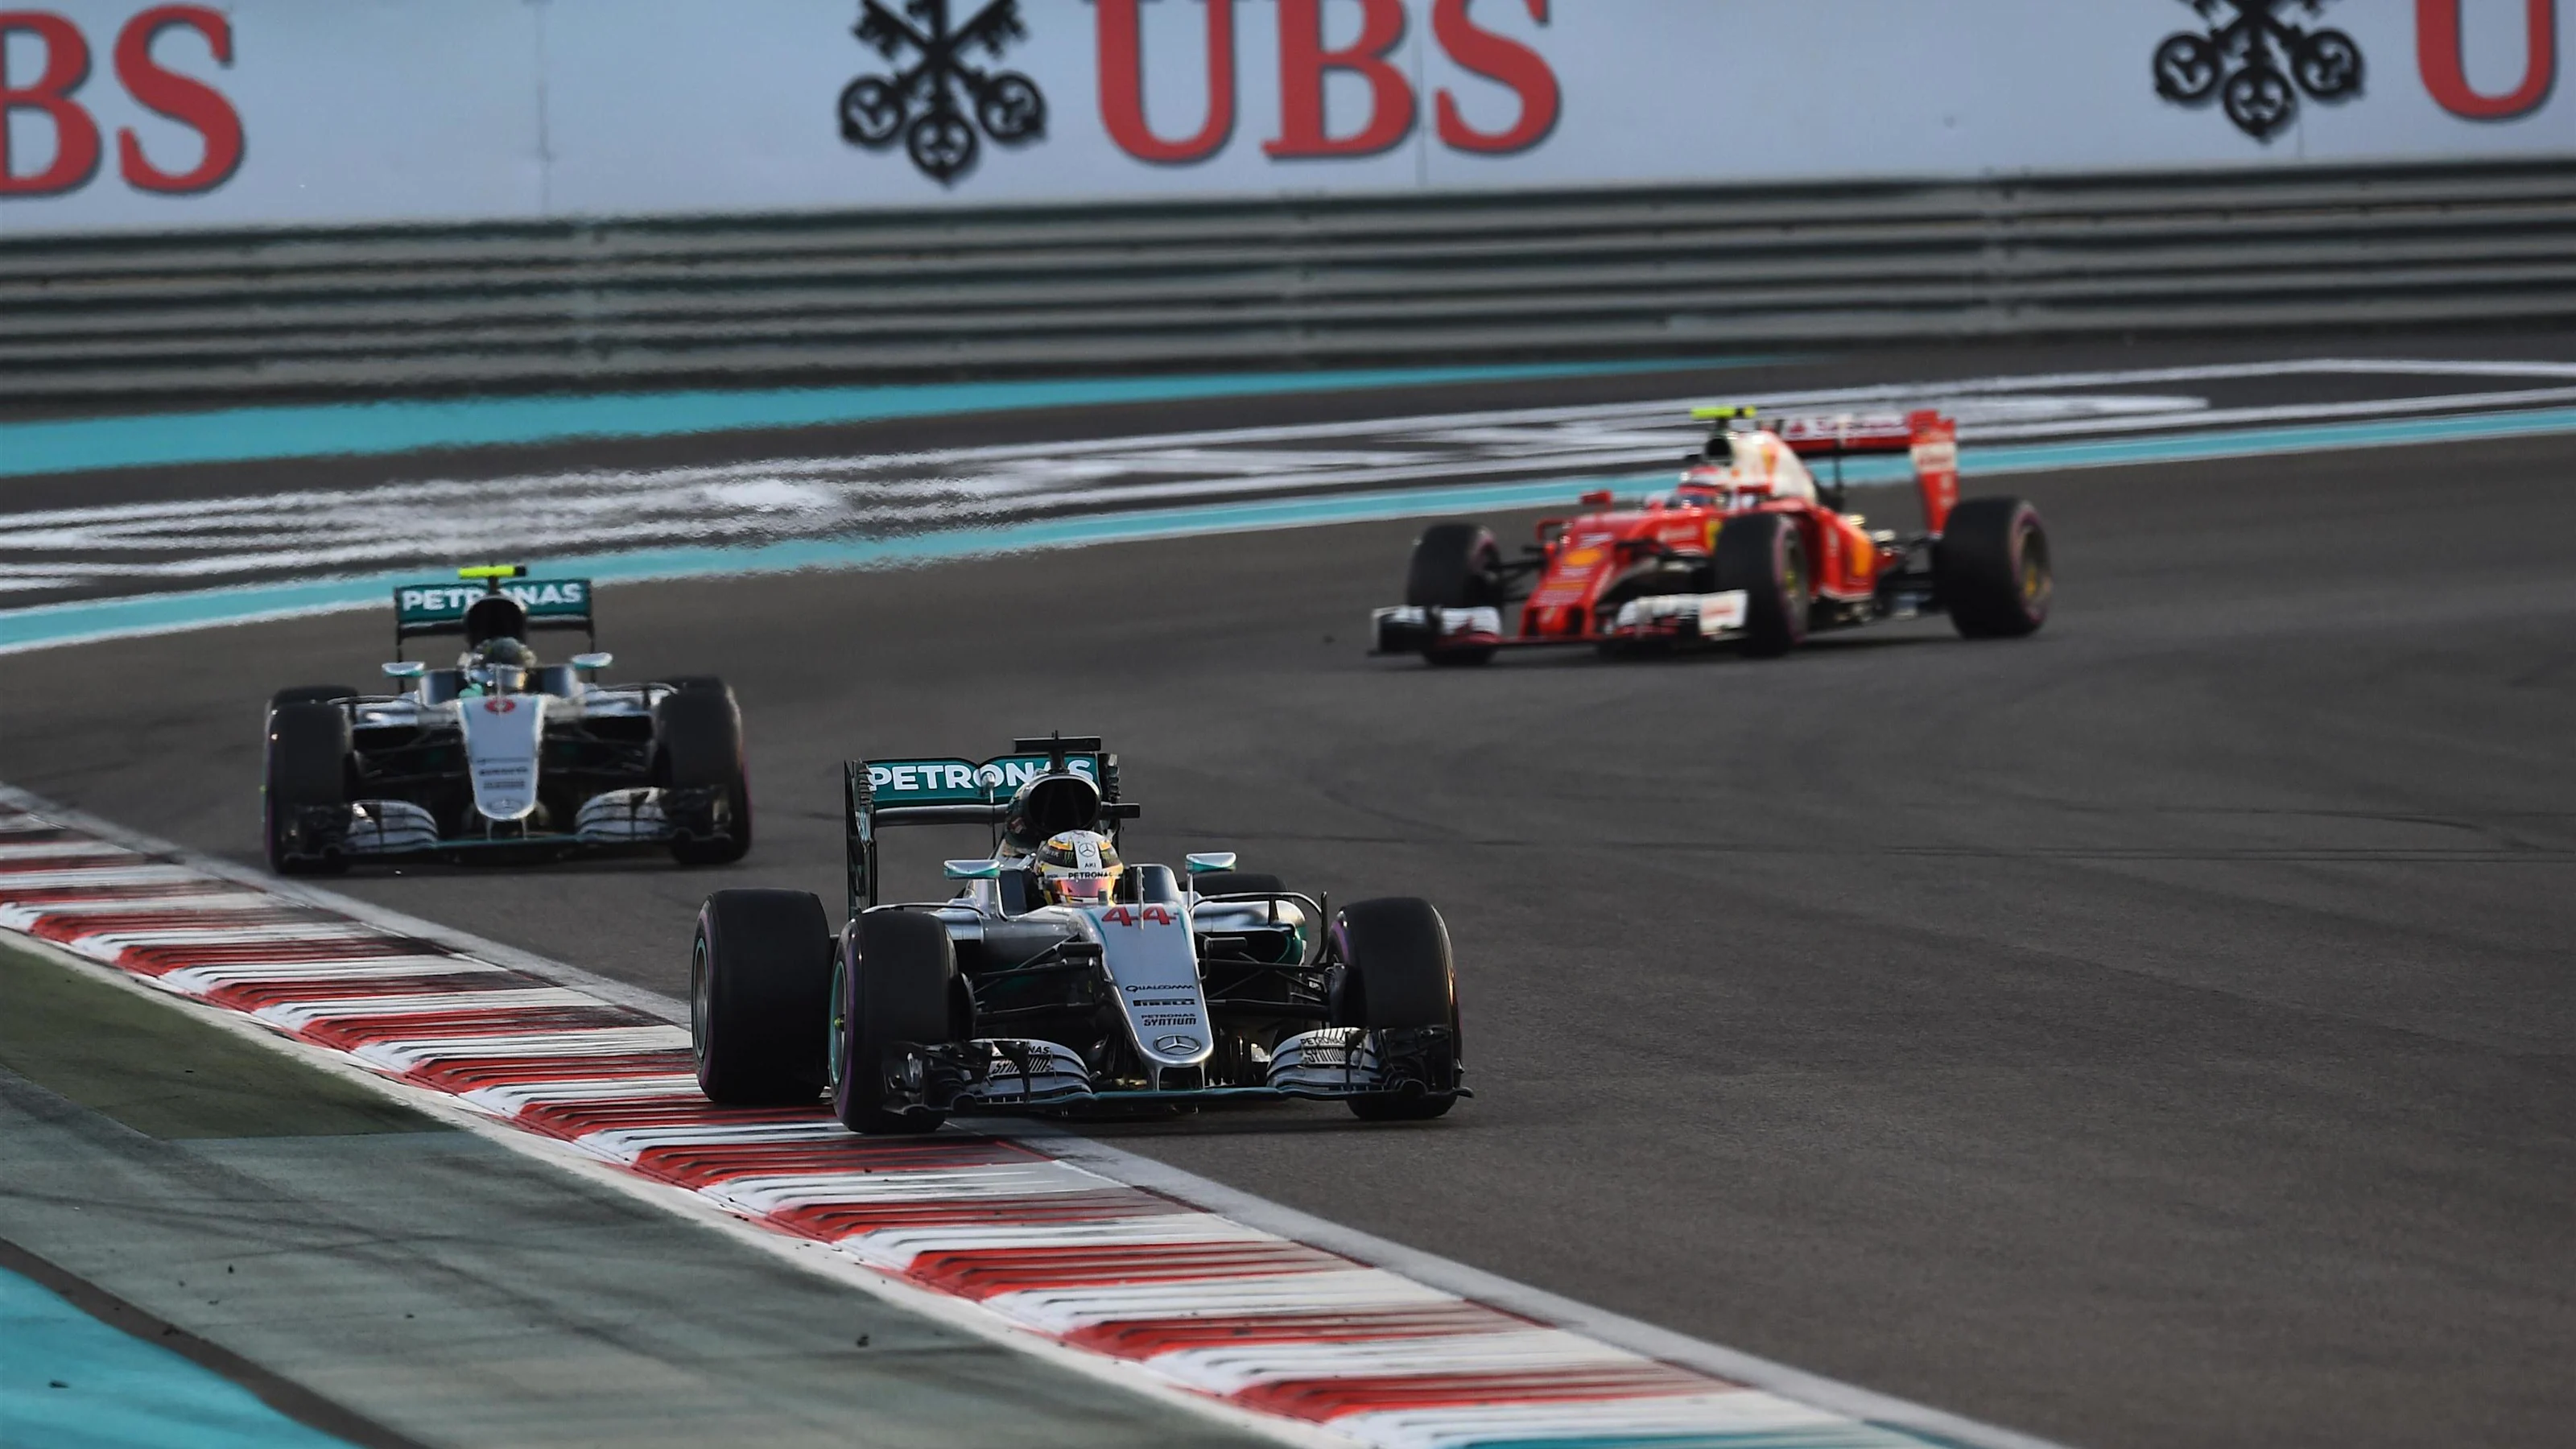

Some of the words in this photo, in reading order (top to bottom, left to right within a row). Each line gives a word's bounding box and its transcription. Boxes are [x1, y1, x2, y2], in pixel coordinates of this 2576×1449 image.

[2417, 0, 2556, 122] U
[1093, 0, 1561, 165] UBS
[402, 583, 581, 611] PETRNAS
[869, 759, 1094, 791] PETRONS
[1101, 906, 1176, 927] 44
[1125, 985, 1195, 993] QUALCOMM
[1133, 998, 1195, 1007] PIRELLI
